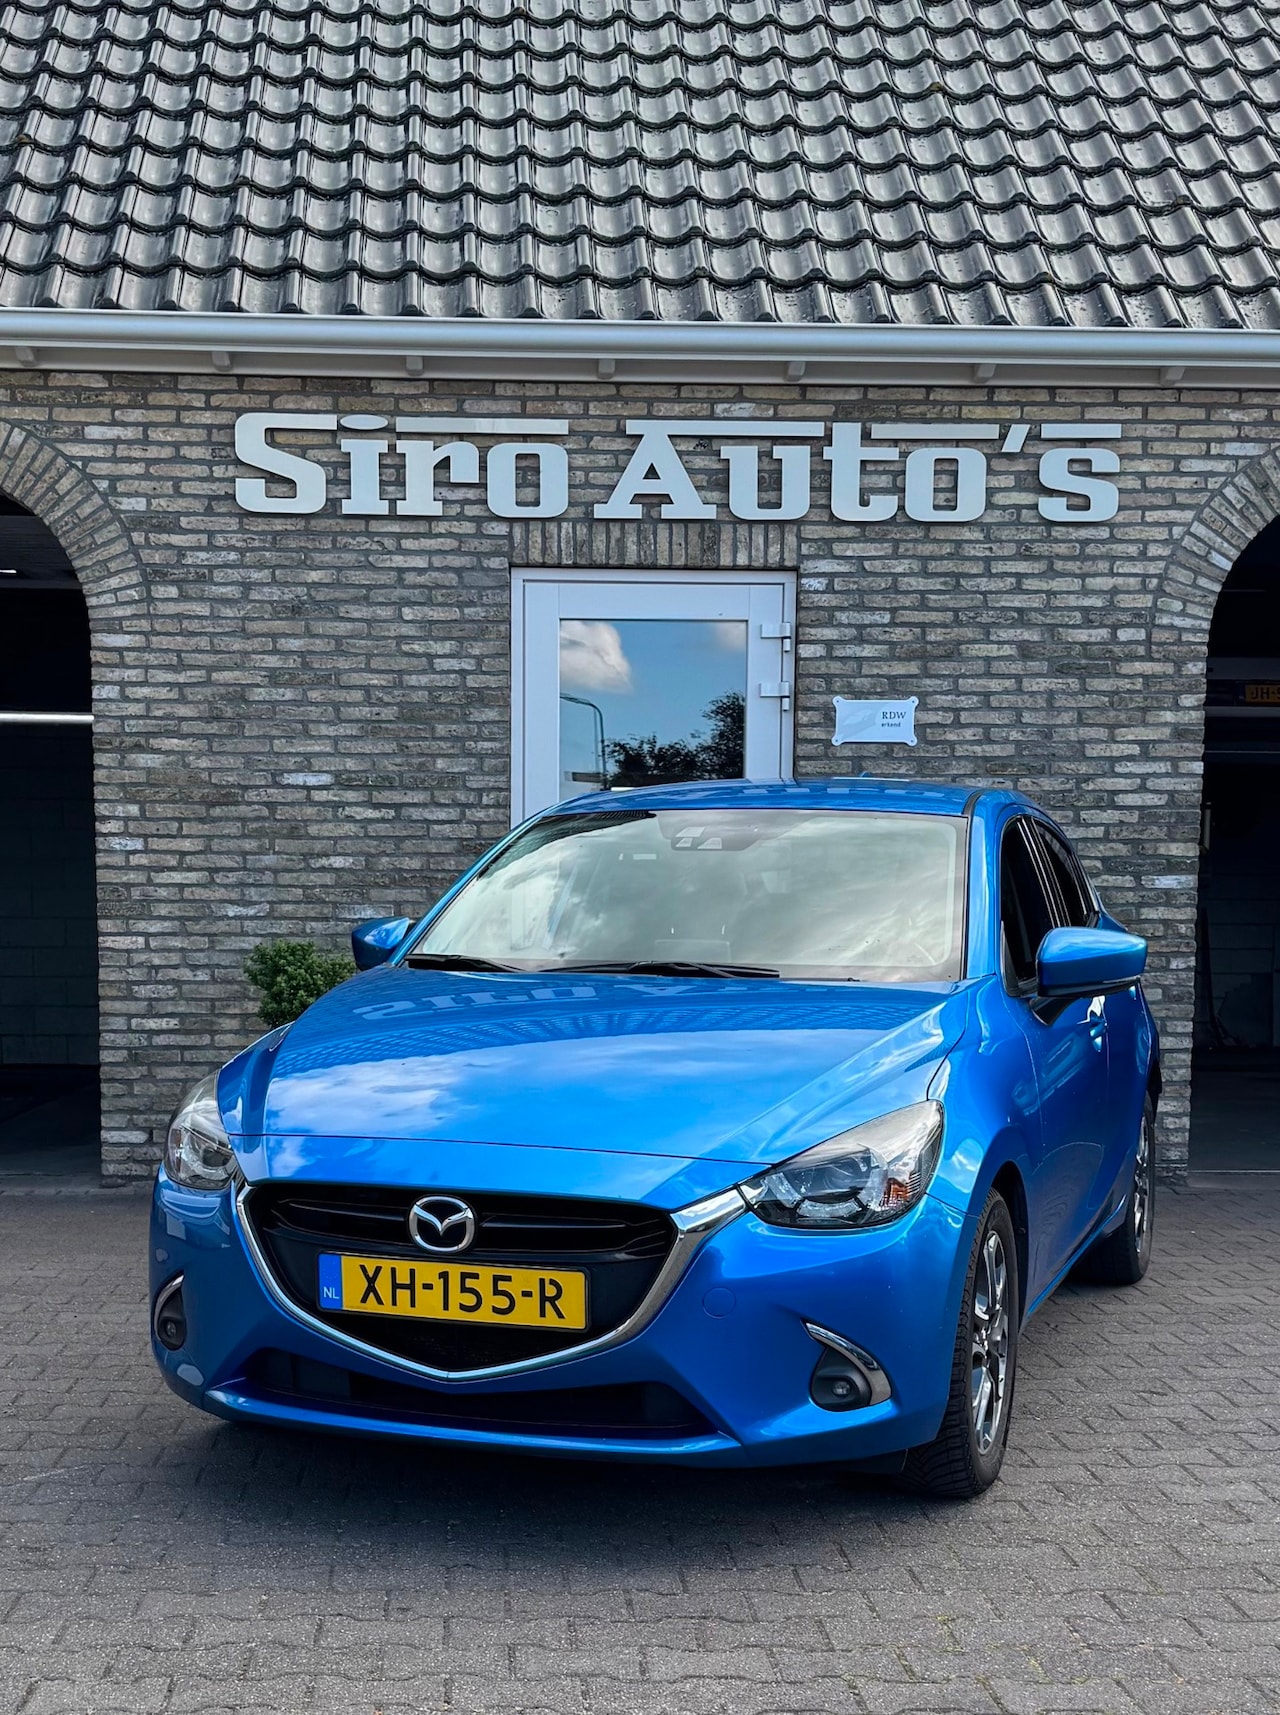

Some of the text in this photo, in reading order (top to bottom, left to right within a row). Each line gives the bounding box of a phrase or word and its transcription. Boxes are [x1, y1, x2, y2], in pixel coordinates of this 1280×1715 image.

[234, 412, 1122, 523] Siro Auto's
[882, 711, 907, 720] RDW
[323, 1264, 566, 1320] NL XH-155-R
